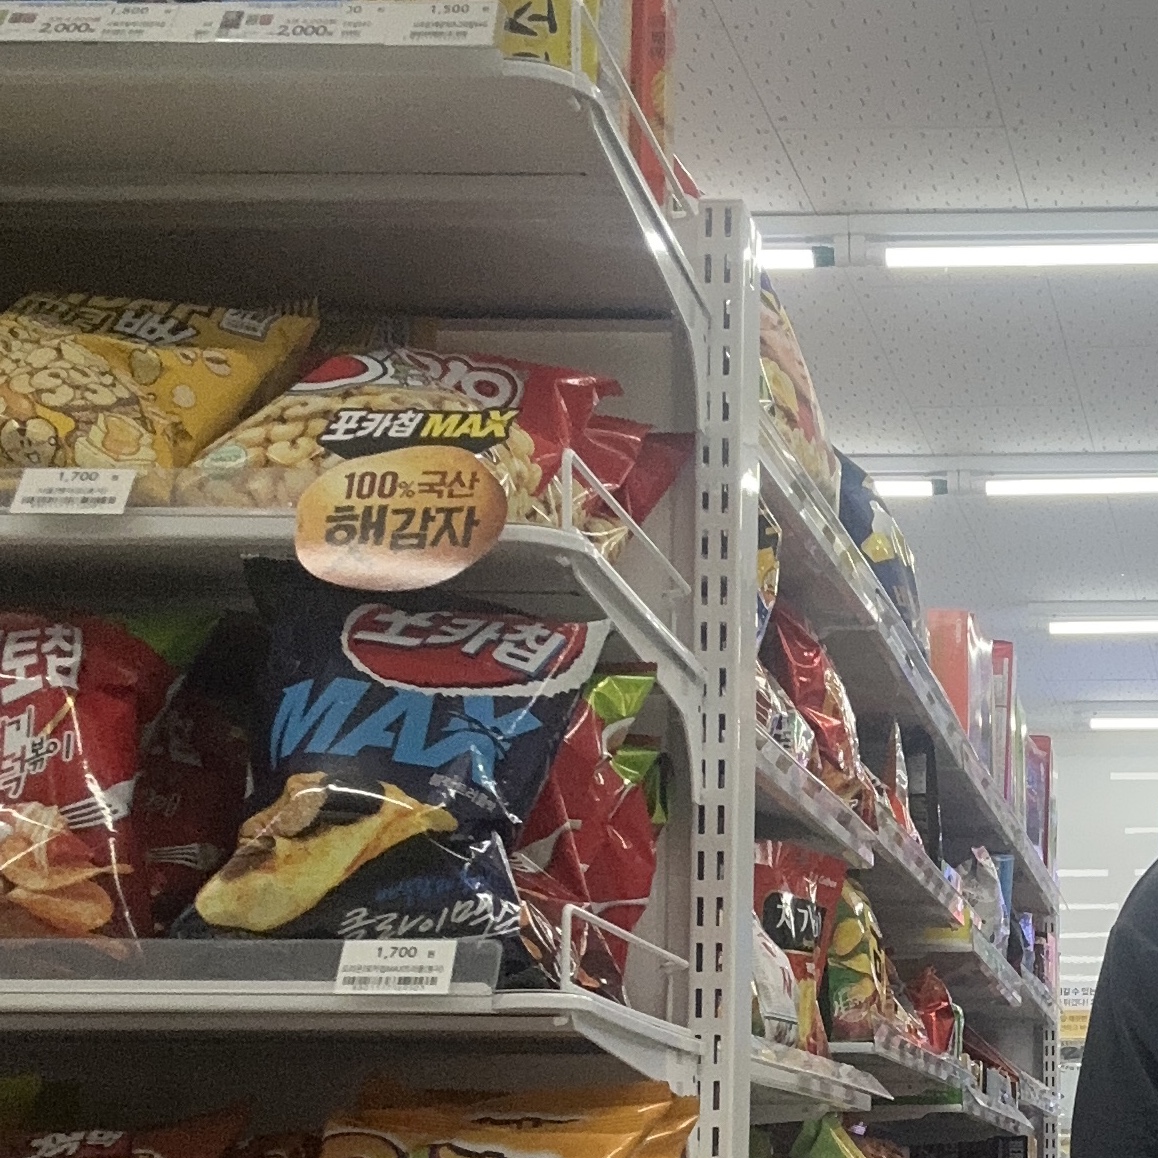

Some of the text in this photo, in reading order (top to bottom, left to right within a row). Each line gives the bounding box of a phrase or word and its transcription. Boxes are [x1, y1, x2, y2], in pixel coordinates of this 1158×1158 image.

[322, 409, 519, 441] 포카칩 MAX
[58, 471, 99, 483] 1,700
[0, 624, 83, 705] 토칩
[353, 608, 568, 677] 포카칩
[270, 677, 544, 796] MAX
[377, 946, 418, 959] 1,700
